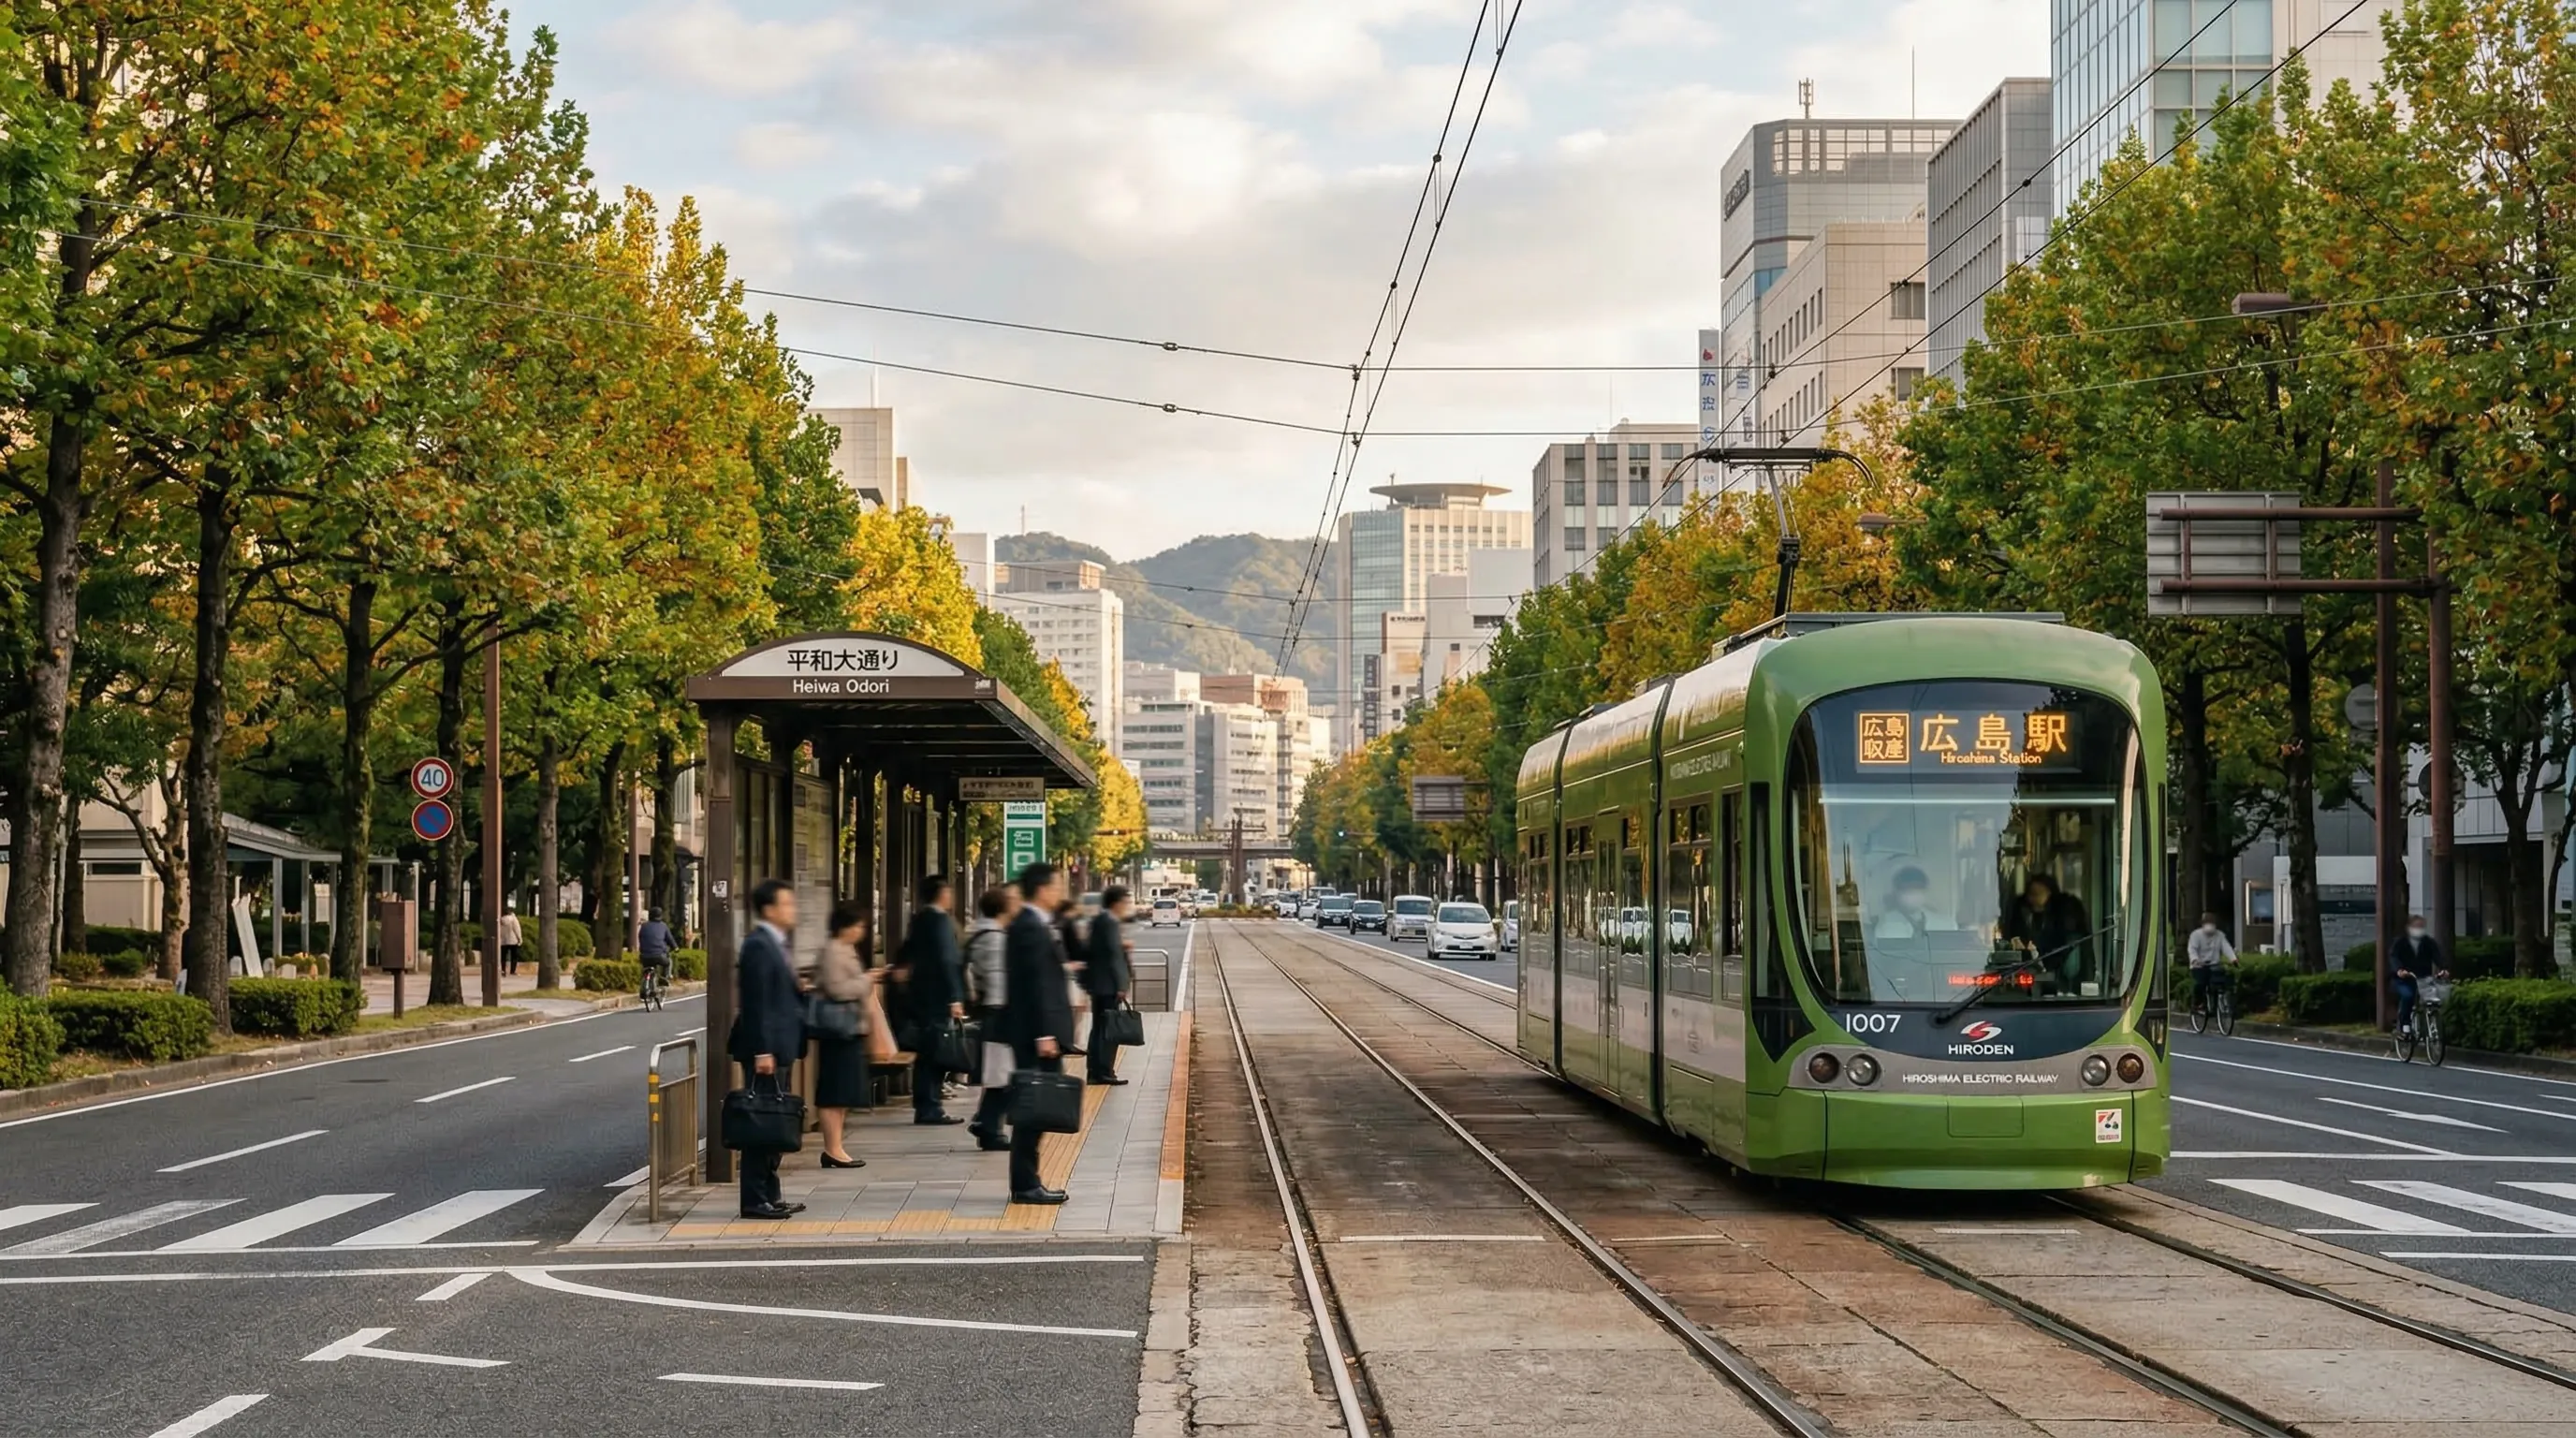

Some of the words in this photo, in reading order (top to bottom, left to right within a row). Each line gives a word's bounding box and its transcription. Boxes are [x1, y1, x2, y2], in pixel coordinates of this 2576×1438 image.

[787, 649, 898, 671] 平和大通り
[793, 679, 840, 693] Heiwa
[846, 679, 889, 693] Odori
[1864, 716, 1904, 738] 広島
[1921, 713, 2067, 752] 広島駅
[1999, 750, 2042, 763] Station
[421, 768, 445, 786] 40
[1846, 1013, 1902, 1033] 1007
[1948, 1044, 2014, 1055] HIRODEN
[1963, 1074, 2012, 1083] ELECTRIC
[2015, 1074, 2058, 1083] RAILWAY
